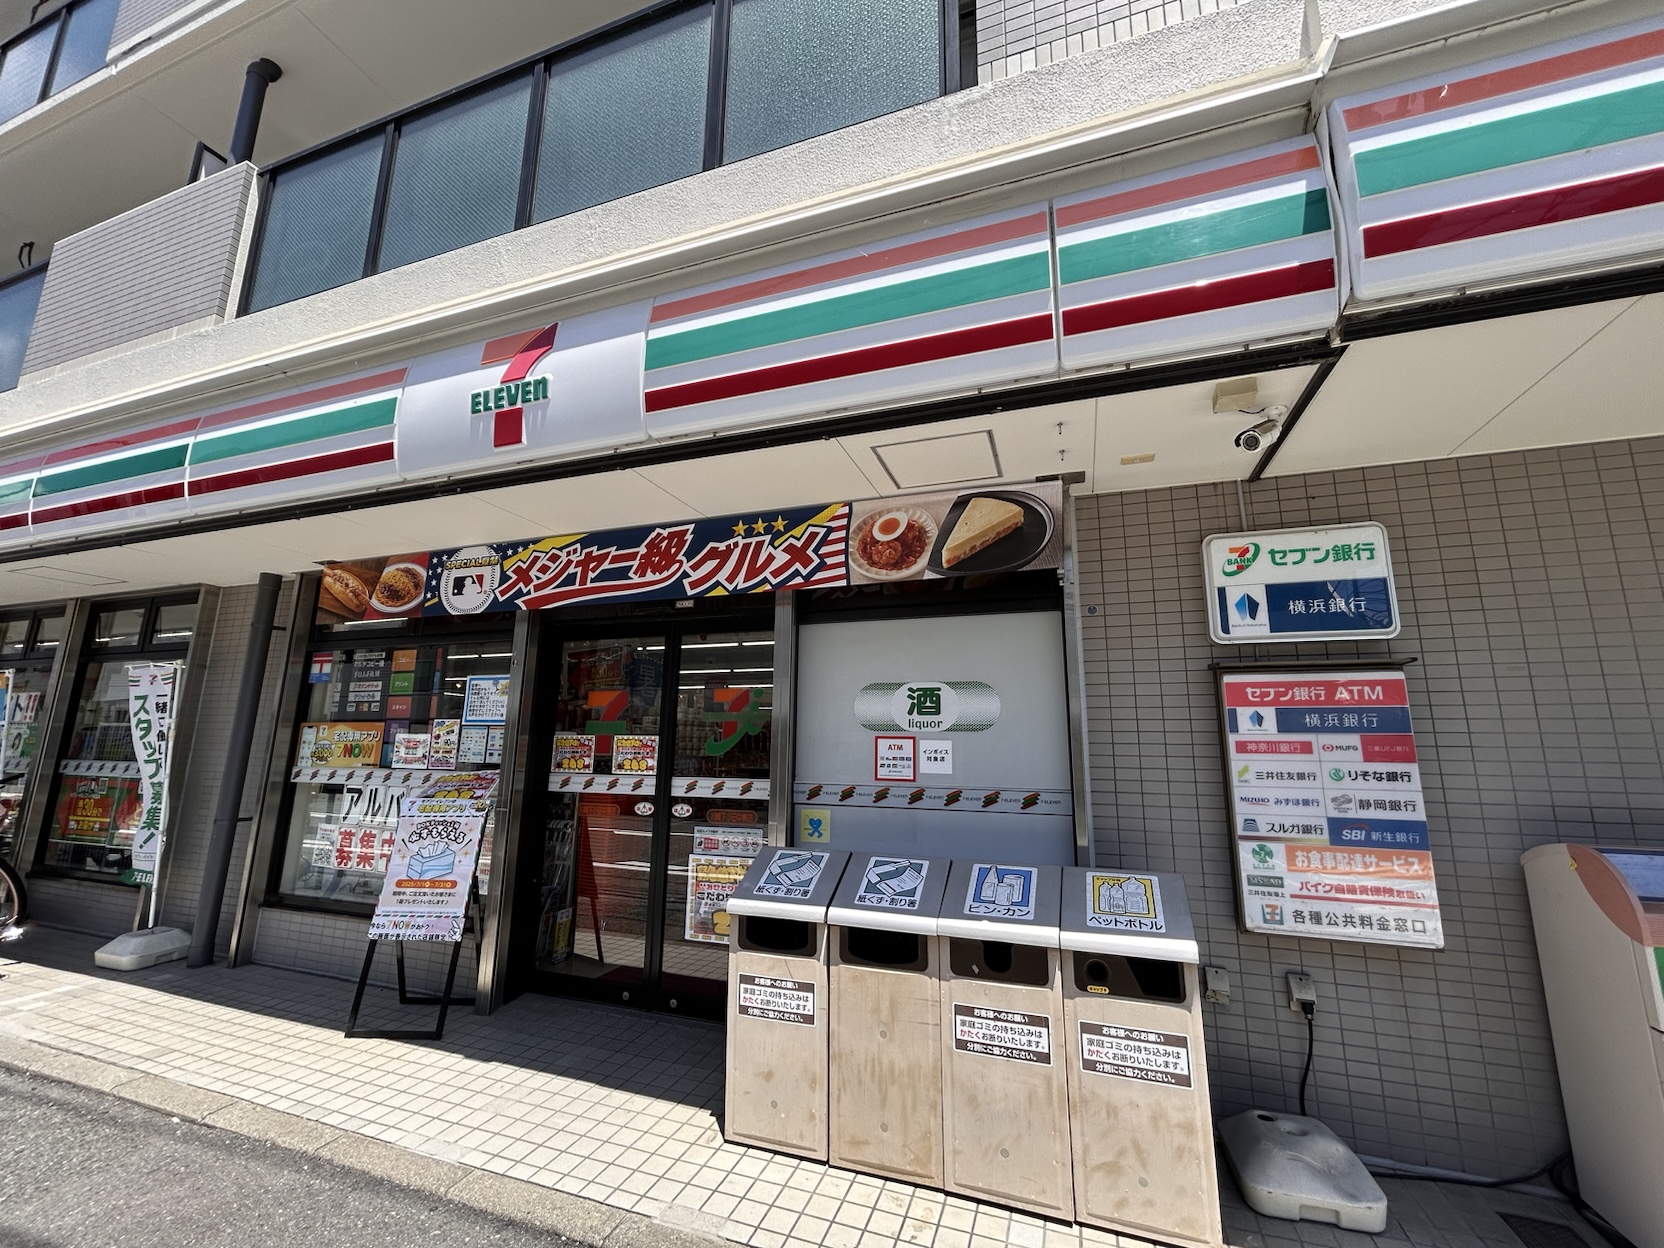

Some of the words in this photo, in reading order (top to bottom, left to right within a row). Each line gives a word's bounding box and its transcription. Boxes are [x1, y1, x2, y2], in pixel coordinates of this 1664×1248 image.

[470, 376, 549, 415] ELEVEN
[1227, 557, 1253, 566] BANK
[1268, 542, 1375, 566] セブン銀行
[1288, 597, 1366, 614] 横浜銀行
[906, 686, 941, 716] 酒
[1245, 686, 1325, 702] セブン銀行
[1334, 685, 1384, 701] ATM
[907, 718, 943, 730] liquor
[1304, 713, 1378, 728] 横浜銀行
[337, 743, 375, 758] 7NOW
[887, 743, 904, 751] ATM
[922, 748, 949, 756] インボイス
[1246, 742, 1302, 753] 神奈川銀行
[1255, 771, 1317, 781] 三井住友銀行
[1348, 770, 1412, 782] りそな銀行
[1239, 796, 1270, 804] MIZUHO
[1273, 797, 1320, 807] みずほ銀行
[1358, 799, 1417, 813] 静岡銀行
[1265, 822, 1324, 835] スルガ銀行
[1341, 830, 1366, 841] SBI
[1370, 831, 1420, 843] 新生銀行
[1295, 850, 1422, 874] お食事配達サービス
[967, 904, 1031, 917] ビン・カン
[1089, 915, 1163, 931] ペットボトル
[1292, 909, 1427, 934] 各種公共料金窓口
[754, 977, 798, 989] お客様へのお願い
[742, 986, 809, 1002] 家庭ゴミの持ち込みは
[742, 996, 811, 1012] かたくお断りいたします。
[747, 1007, 804, 1022] 分別にご協力ください。
[973, 1008, 1028, 1023] お客様へのお願い
[959, 1019, 1043, 1038] 家庭ゴミの持ち込みは
[1102, 1026, 1164, 1042] お客様へのお願い
[959, 1028, 1046, 1050] かたくお断りいたします。
[966, 1042, 1037, 1061] 分別にご協力ください。
[1086, 1037, 1181, 1059] 家庭ゴミの持ち込みは
[1086, 1048, 1185, 1071] かたくお断りいたします。
[1095, 1061, 1175, 1083] 分別にご協力ください。
